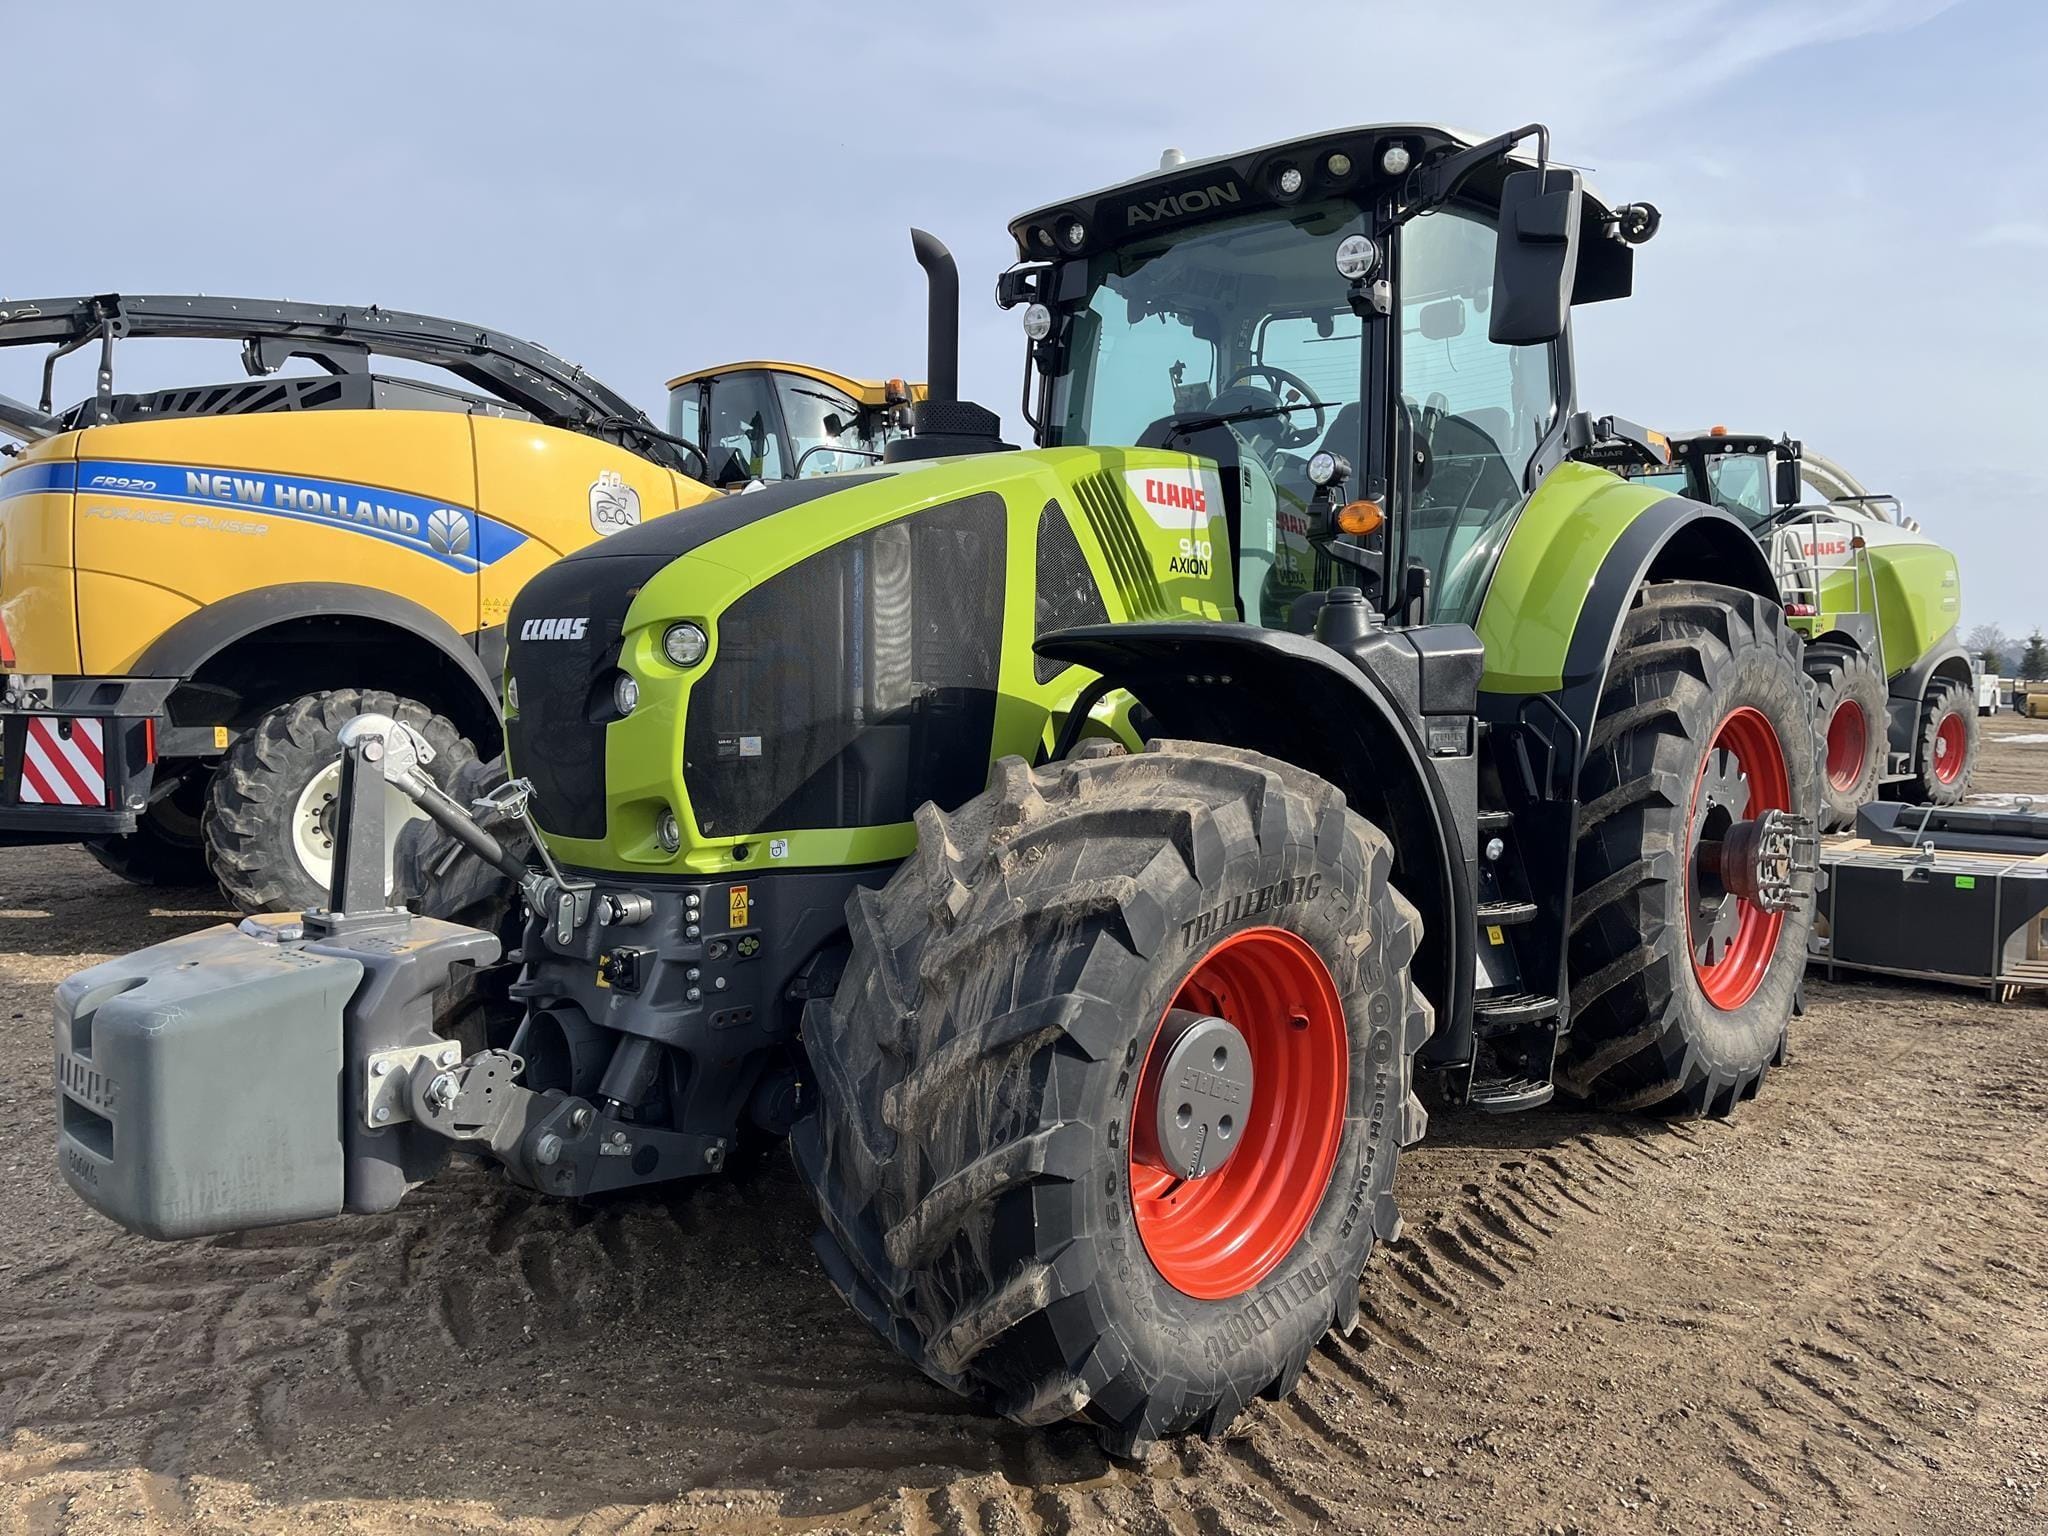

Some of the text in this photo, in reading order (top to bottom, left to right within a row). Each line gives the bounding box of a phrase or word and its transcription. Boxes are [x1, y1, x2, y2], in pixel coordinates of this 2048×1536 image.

[1128, 181, 1240, 226] AXION
[90, 475, 157, 491] FR920
[186, 471, 420, 534] NEW HOLLAND
[1145, 479, 1206, 513] CLAAS
[84, 505, 269, 537] FORAGE CRUISER
[1169, 556, 1208, 576] AXION
[1178, 537, 1213, 560] 940
[520, 617, 591, 641] CLAAS
[1180, 872, 1323, 951] TRELLEBORG
[1113, 1038, 1138, 1101] 30
[1369, 1072, 1388, 1142] HIGH
[1108, 1118, 1121, 1149] R
[1339, 1145, 1376, 1240] POWER
[1202, 1251, 1338, 1373] TRELLEBORG
